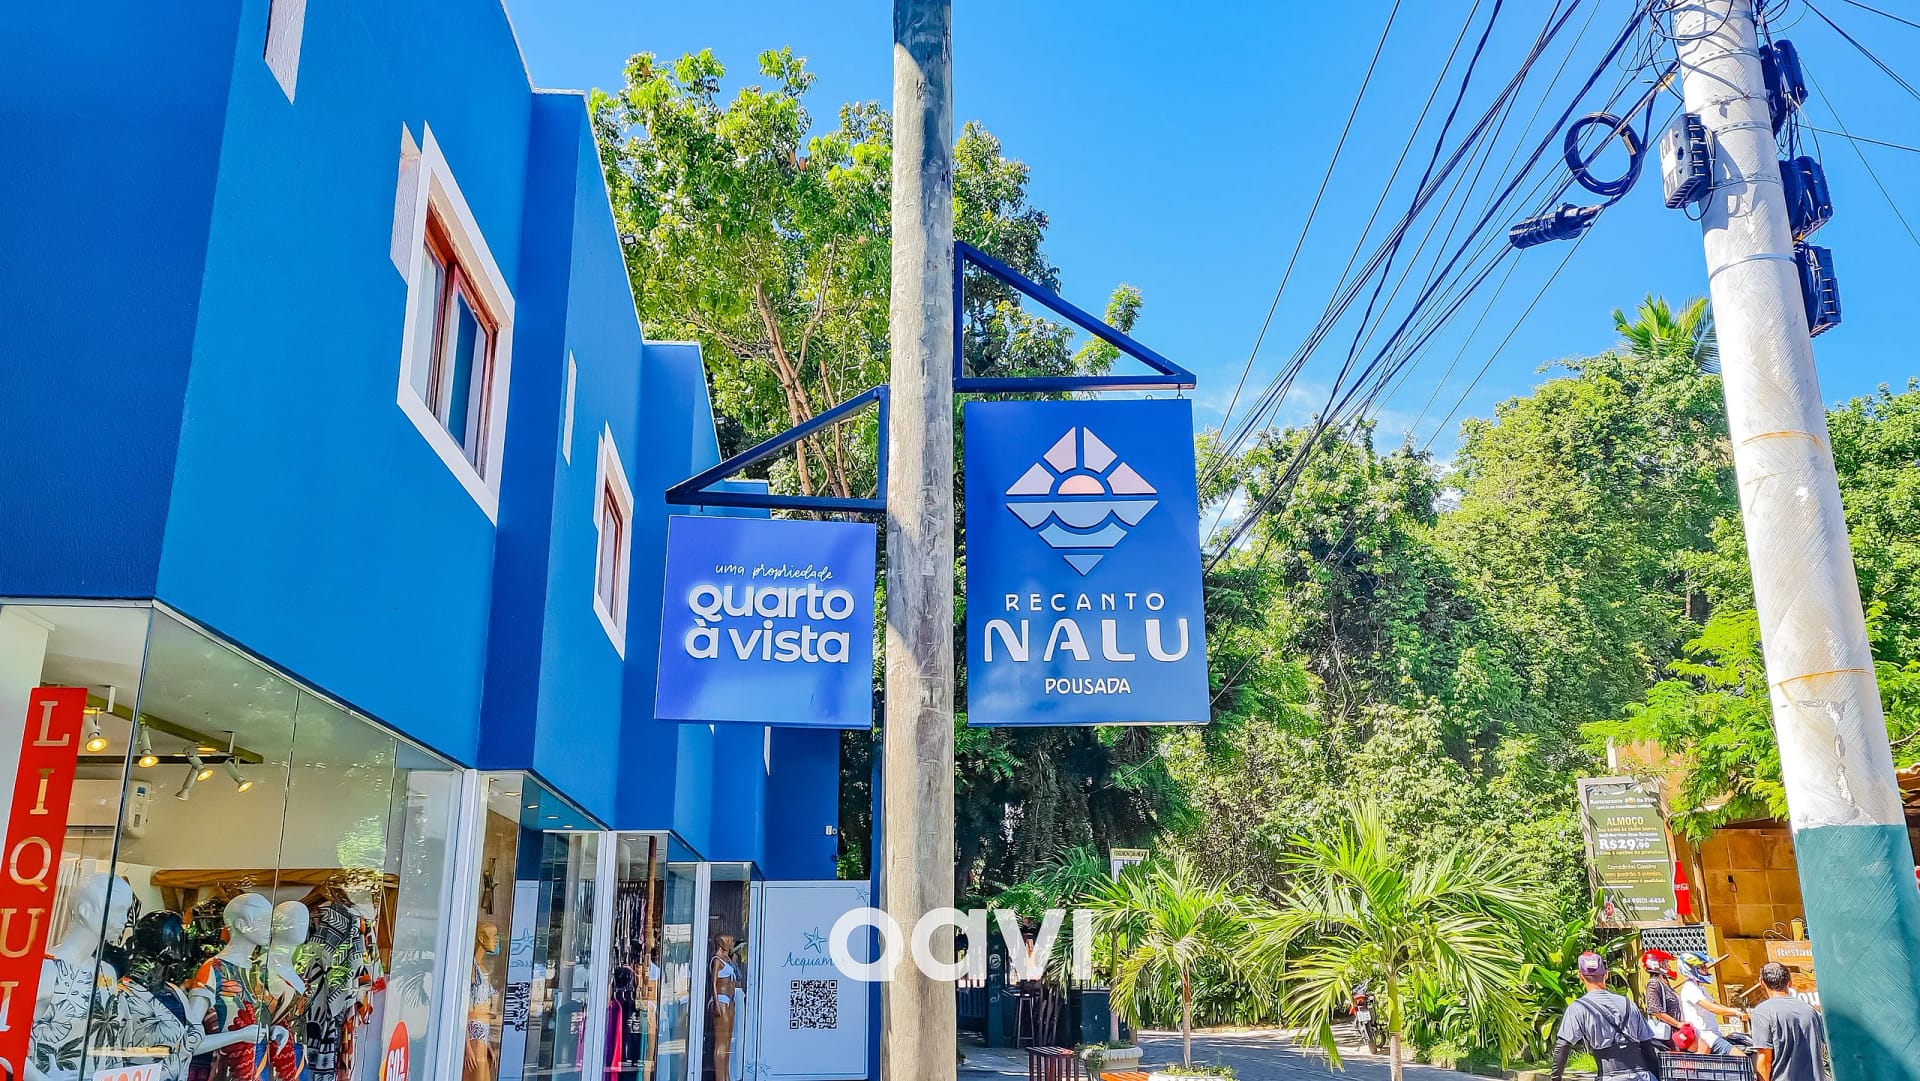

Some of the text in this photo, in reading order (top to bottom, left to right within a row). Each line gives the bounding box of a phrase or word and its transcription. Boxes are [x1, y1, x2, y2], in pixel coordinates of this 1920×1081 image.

[715, 563, 832, 582] uma propriedade
[1005, 592, 1166, 611] RECANTO
[685, 619, 850, 663] à vista
[984, 618, 1189, 662] NALU
[1045, 677, 1131, 695] POUSADA
[1606, 816, 1644, 827] ALMOÇO
[0, 701, 70, 1081] LIQUI
[781, 951, 838, 974] Acquam
